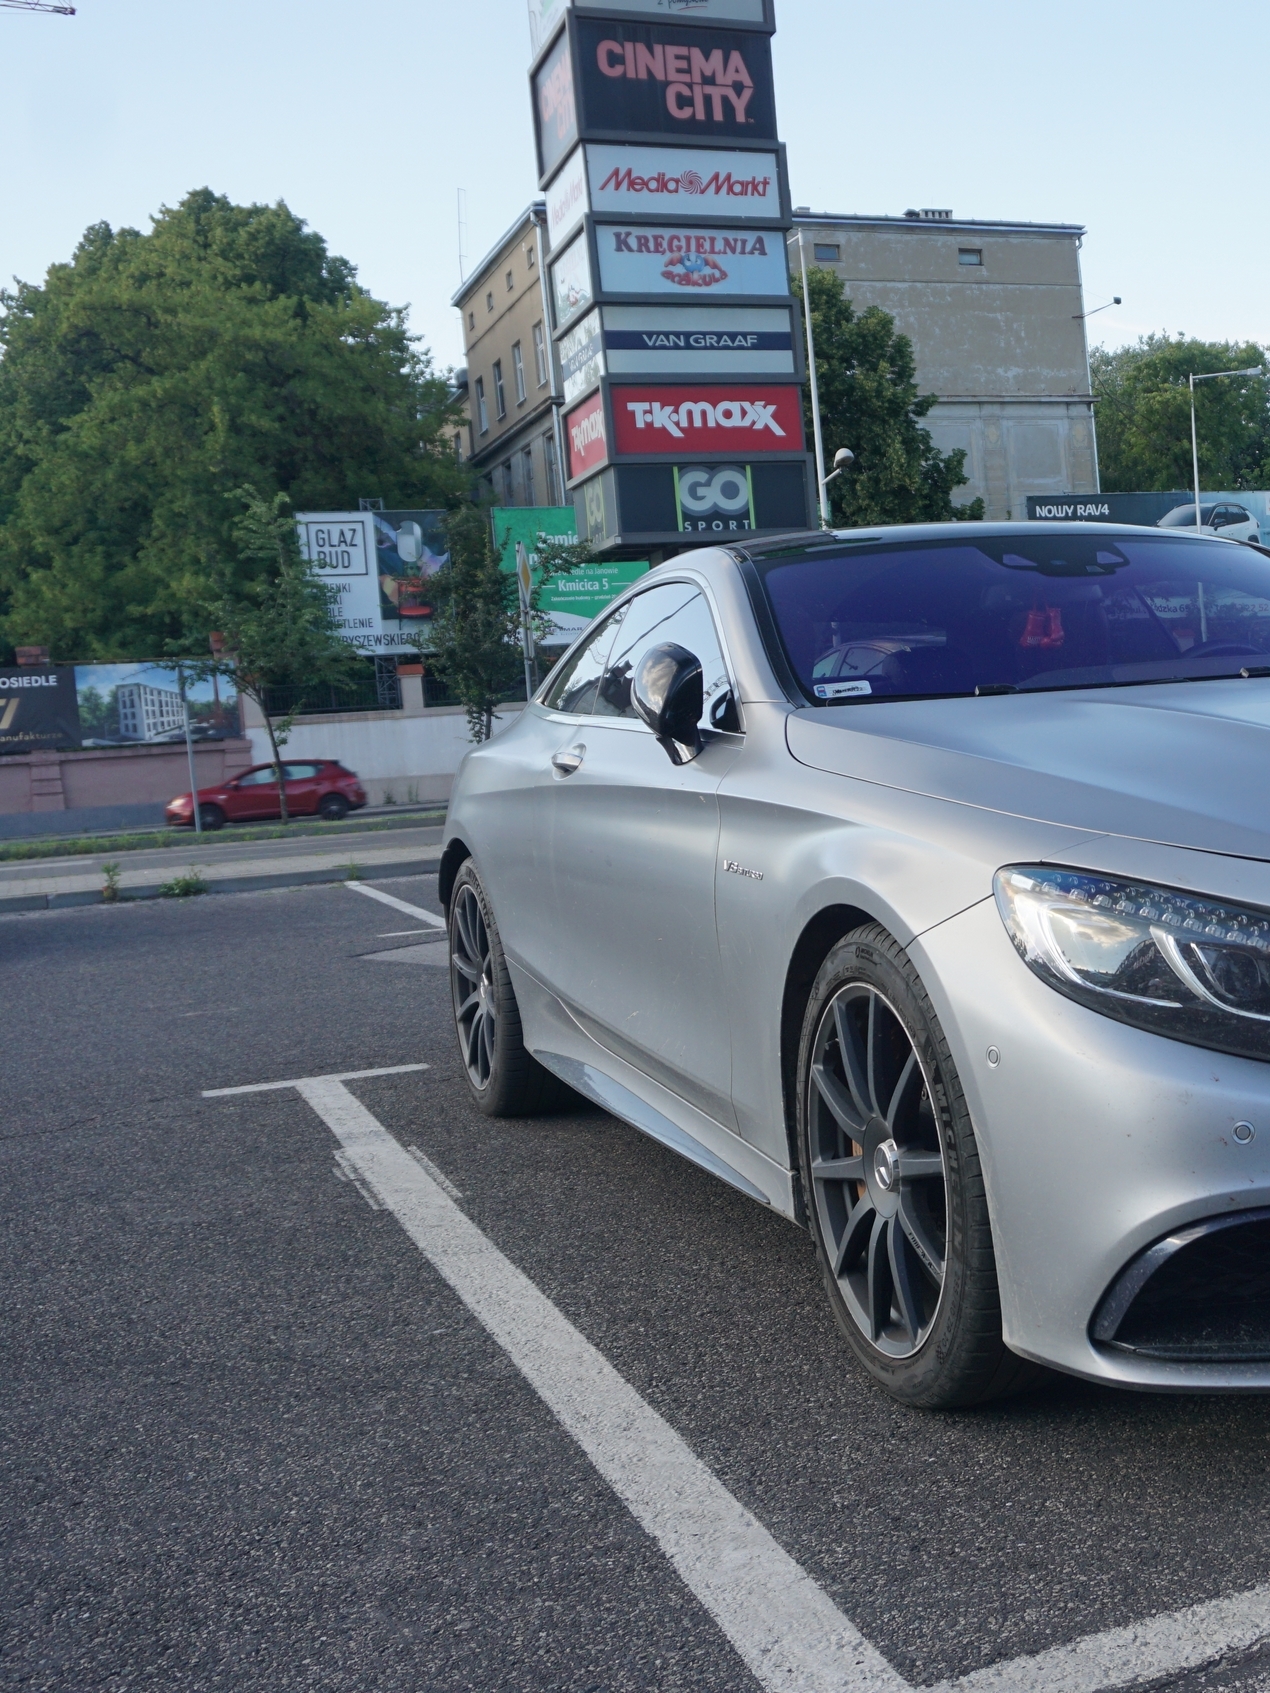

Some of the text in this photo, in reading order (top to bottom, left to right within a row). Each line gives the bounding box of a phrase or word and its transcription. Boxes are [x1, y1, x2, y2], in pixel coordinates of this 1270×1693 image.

[597, 39, 754, 88] CINEMA
[666, 83, 753, 123] CITY
[599, 167, 770, 197] Media Markt
[613, 231, 768, 256] KRĘGIELNIA
[642, 334, 758, 347] VAN GRAAF
[678, 468, 750, 513] GO
[1035, 503, 1110, 517] NOWY RAV4
[685, 519, 750, 532] SPORT
[315, 528, 358, 548] GLAZ
[317, 550, 351, 569] BUD
[595, 567, 618, 575] Janowie
[558, 578, 609, 592] Kmicica 5
[0, 675, 57, 688] OSIEDLE
